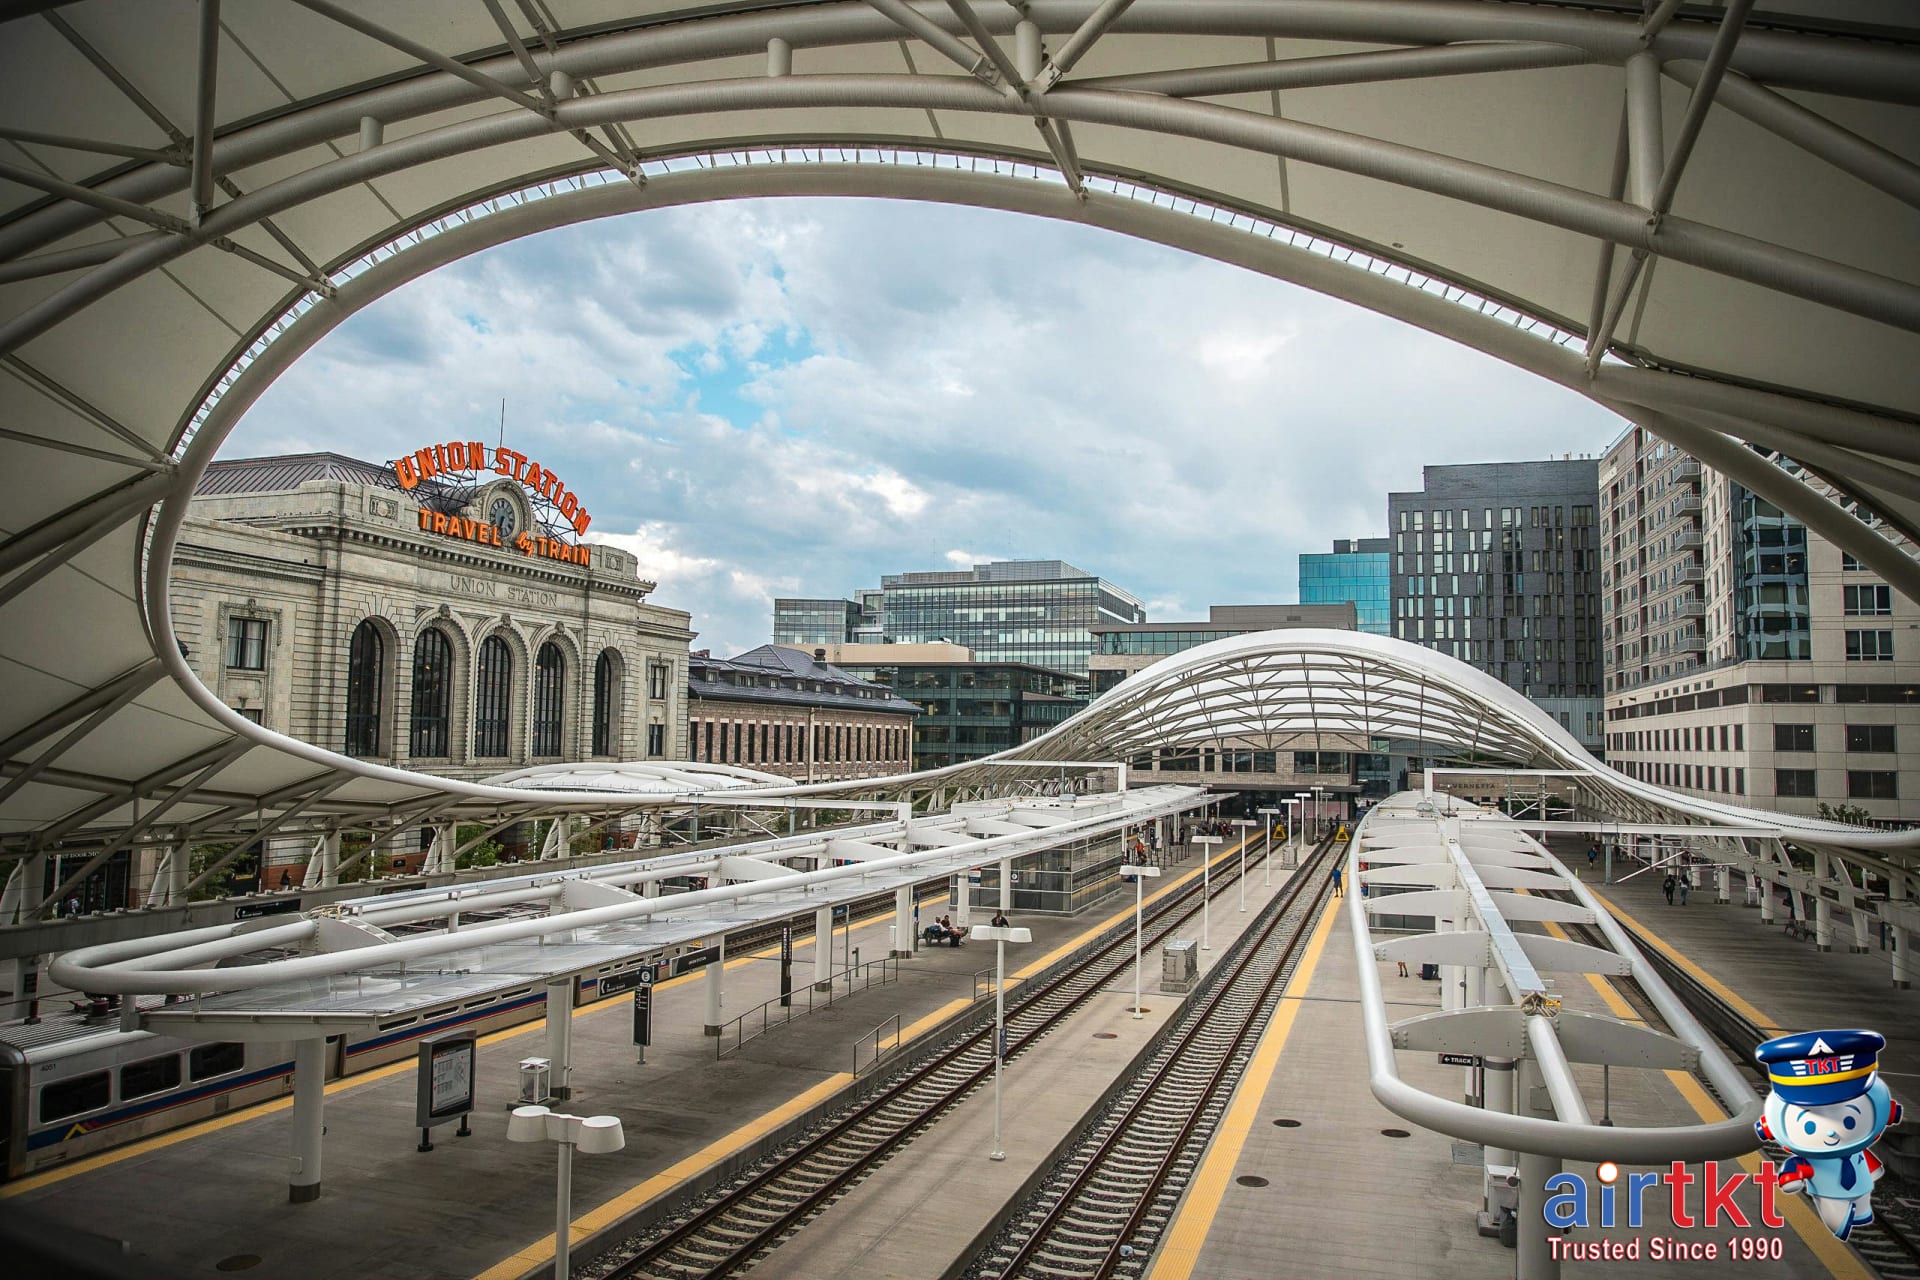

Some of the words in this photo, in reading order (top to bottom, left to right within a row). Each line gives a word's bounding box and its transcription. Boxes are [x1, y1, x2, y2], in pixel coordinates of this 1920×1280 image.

[395, 441, 485, 490] UNION
[494, 447, 592, 537] STATION
[419, 508, 503, 547] TRAVEL
[516, 530, 535, 558] by
[536, 536, 591, 567] TRAIN
[450, 576, 496, 597] UNION
[507, 586, 557, 607] STATION
